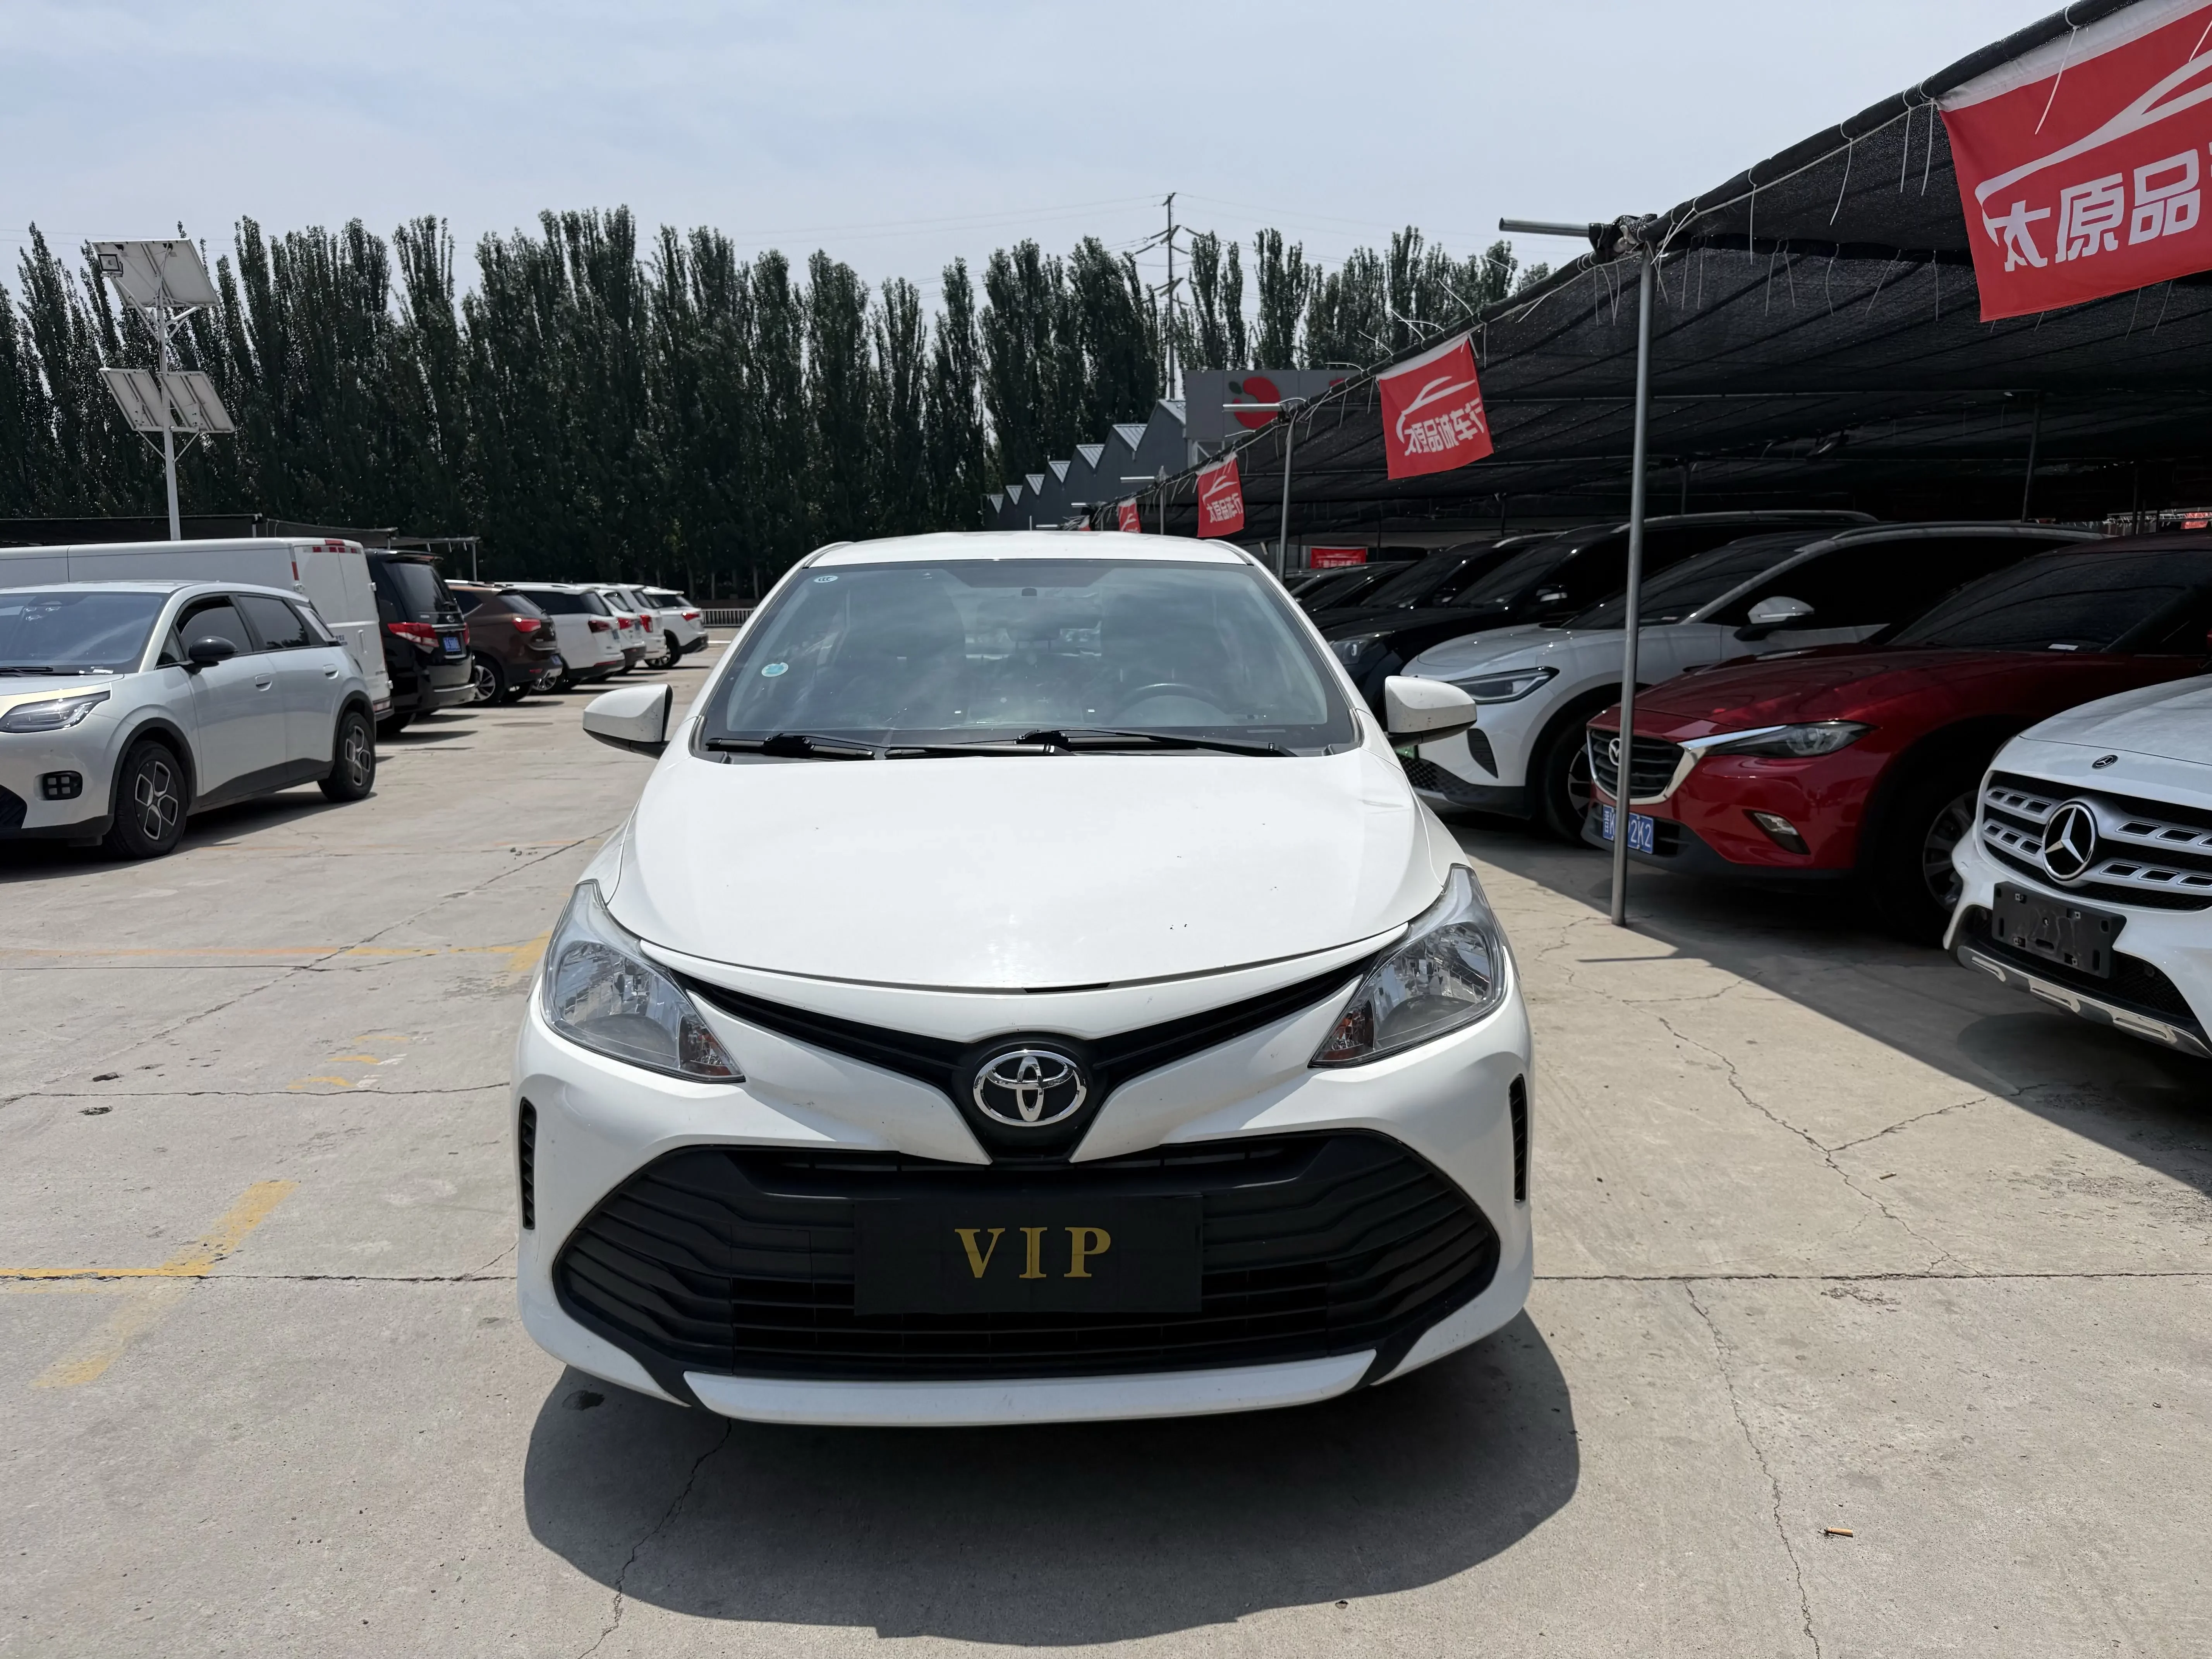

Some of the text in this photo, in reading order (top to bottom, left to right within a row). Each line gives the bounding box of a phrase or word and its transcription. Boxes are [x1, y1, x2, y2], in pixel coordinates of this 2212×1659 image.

[1985, 142, 2212, 272] 太原品
[1604, 811, 1651, 848] 晋K2K2
[955, 1227, 1111, 1278] VIP
